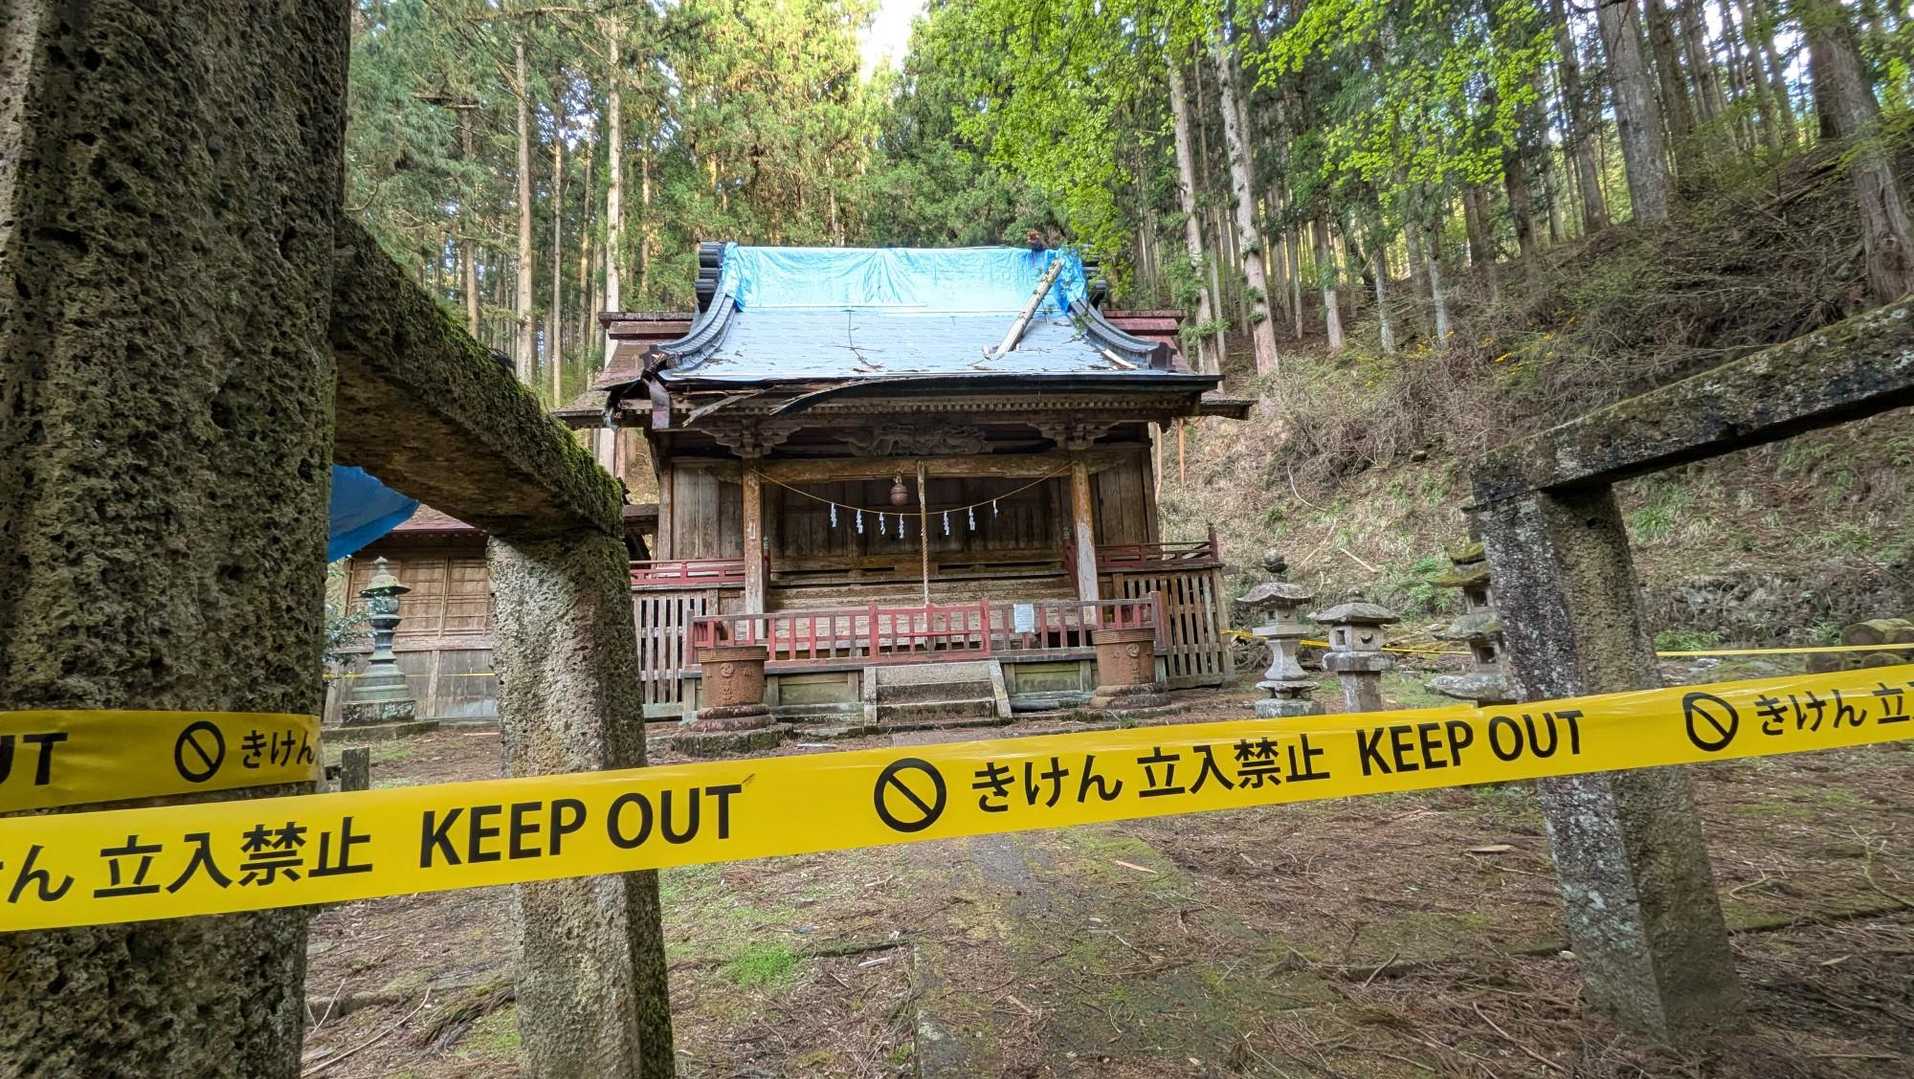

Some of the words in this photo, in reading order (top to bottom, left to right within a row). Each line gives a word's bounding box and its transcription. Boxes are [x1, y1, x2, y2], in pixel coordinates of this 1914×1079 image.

[0, 845, 74, 903] ん
[93, 816, 373, 898] 立入禁止
[420, 799, 587, 868] KEEP
[607, 784, 742, 849] OUT
[971, 754, 1123, 812] きけん
[1137, 735, 1331, 799] 立入禁止
[1357, 720, 1474, 776] KEEP
[1488, 710, 1584, 762] OUT
[1755, 689, 1868, 736] きけん
[1872, 682, 1914, 724] 立
[241, 730, 315, 769] きけん
